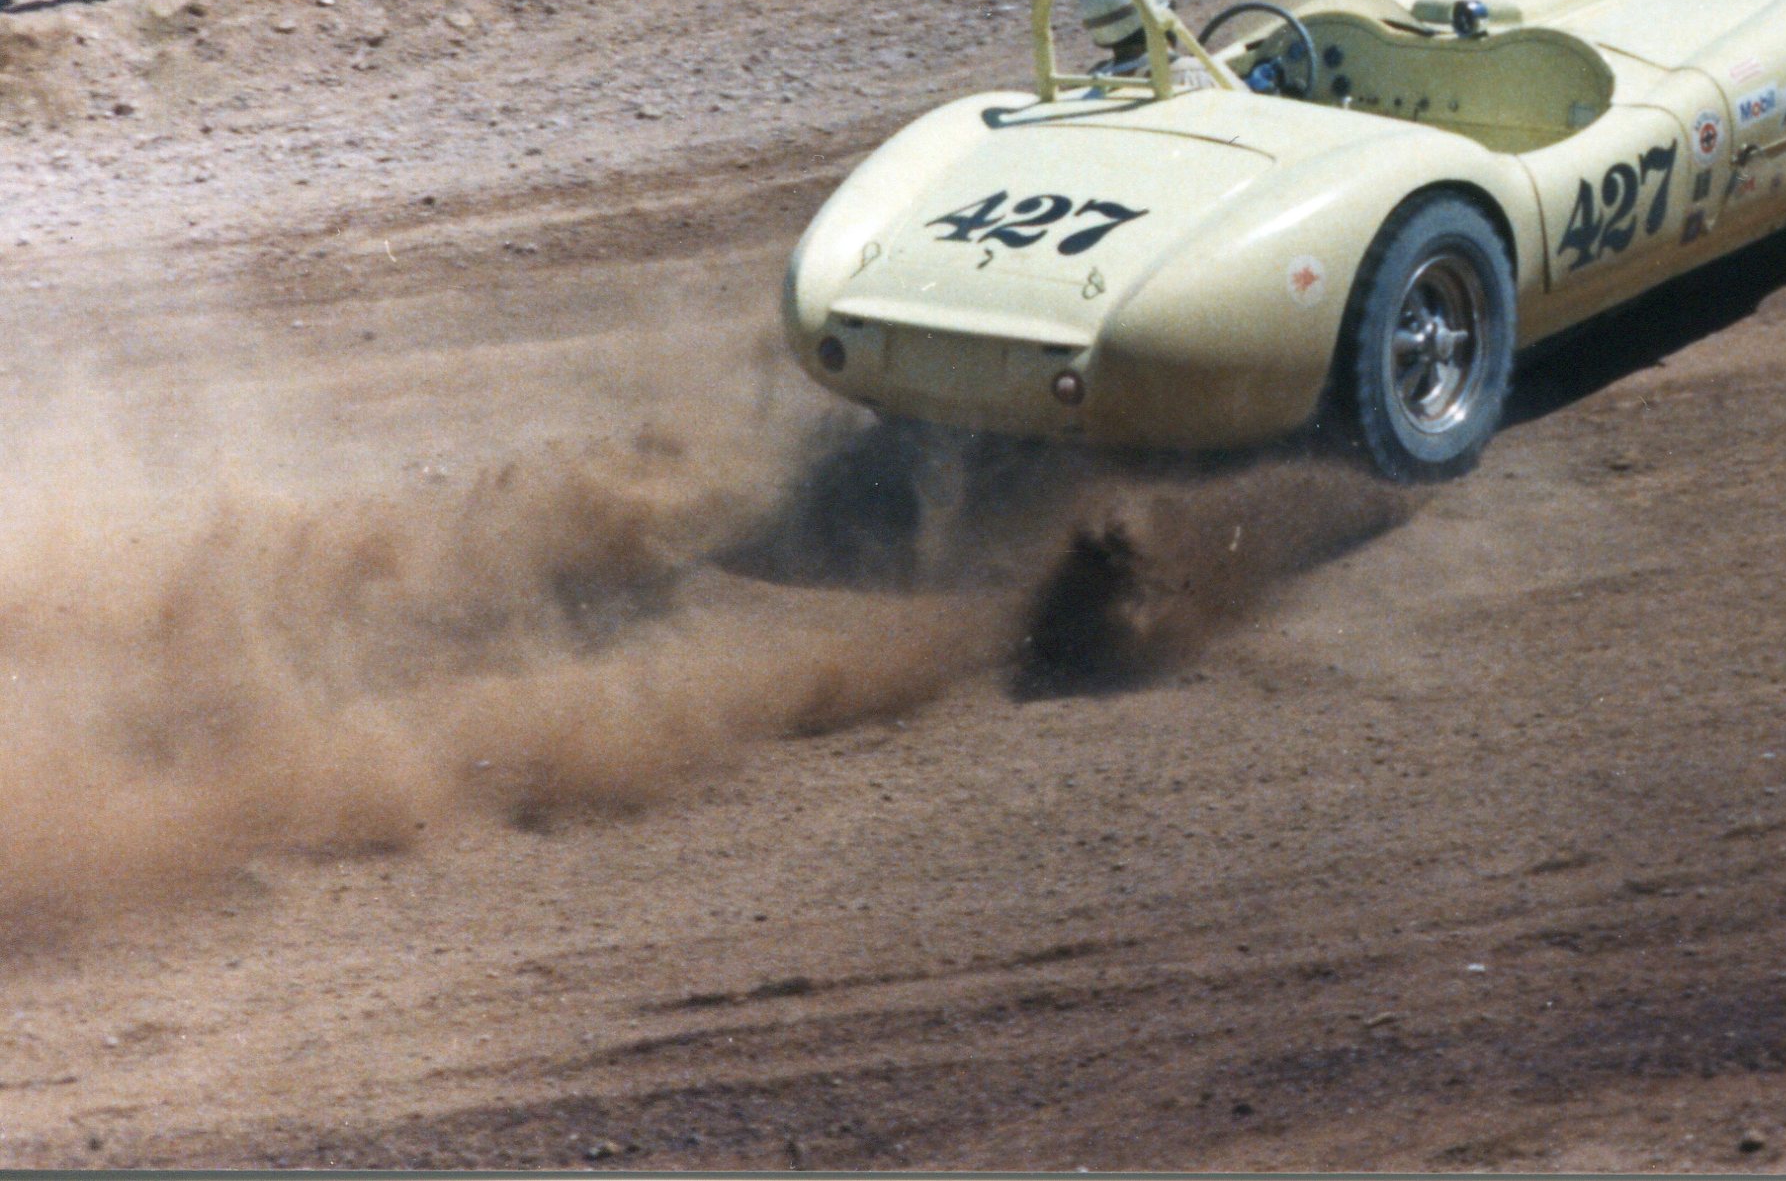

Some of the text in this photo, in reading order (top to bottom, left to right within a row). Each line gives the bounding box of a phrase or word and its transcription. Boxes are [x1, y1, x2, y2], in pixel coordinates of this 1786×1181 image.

[1739, 89, 1776, 119] Mobil
[925, 190, 1149, 256] 427
[1558, 138, 1678, 270] 427
